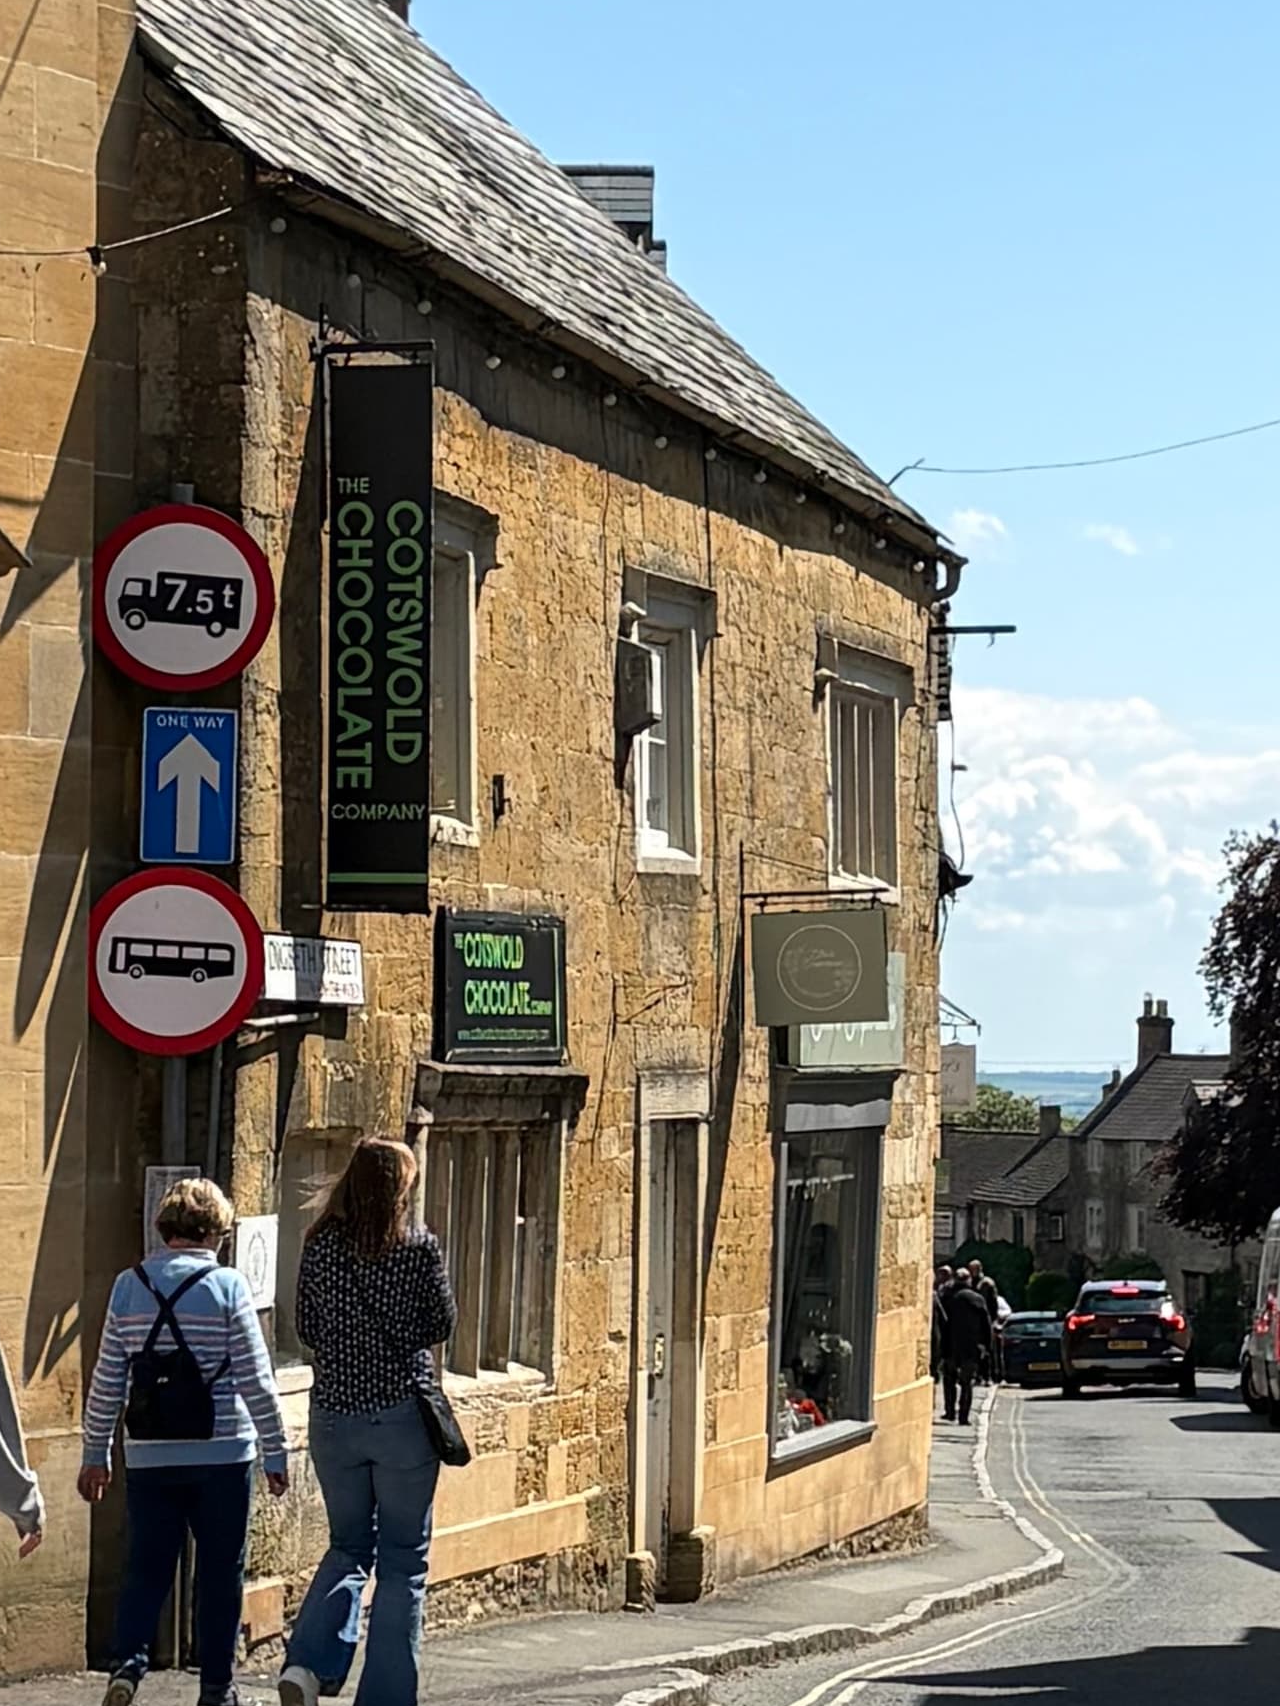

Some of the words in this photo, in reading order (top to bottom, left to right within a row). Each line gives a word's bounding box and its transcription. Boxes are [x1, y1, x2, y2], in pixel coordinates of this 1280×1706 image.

[337, 477, 370, 494] THE
[336, 500, 375, 790] CHOCOLATE
[385, 500, 425, 765] COTSWOLD
[156, 713, 189, 728] ONE
[193, 715, 226, 730] WAY
[331, 803, 427, 821] COMPANY
[464, 932, 525, 970] COTSWOLD
[464, 979, 531, 1015] CHOCOLATE
